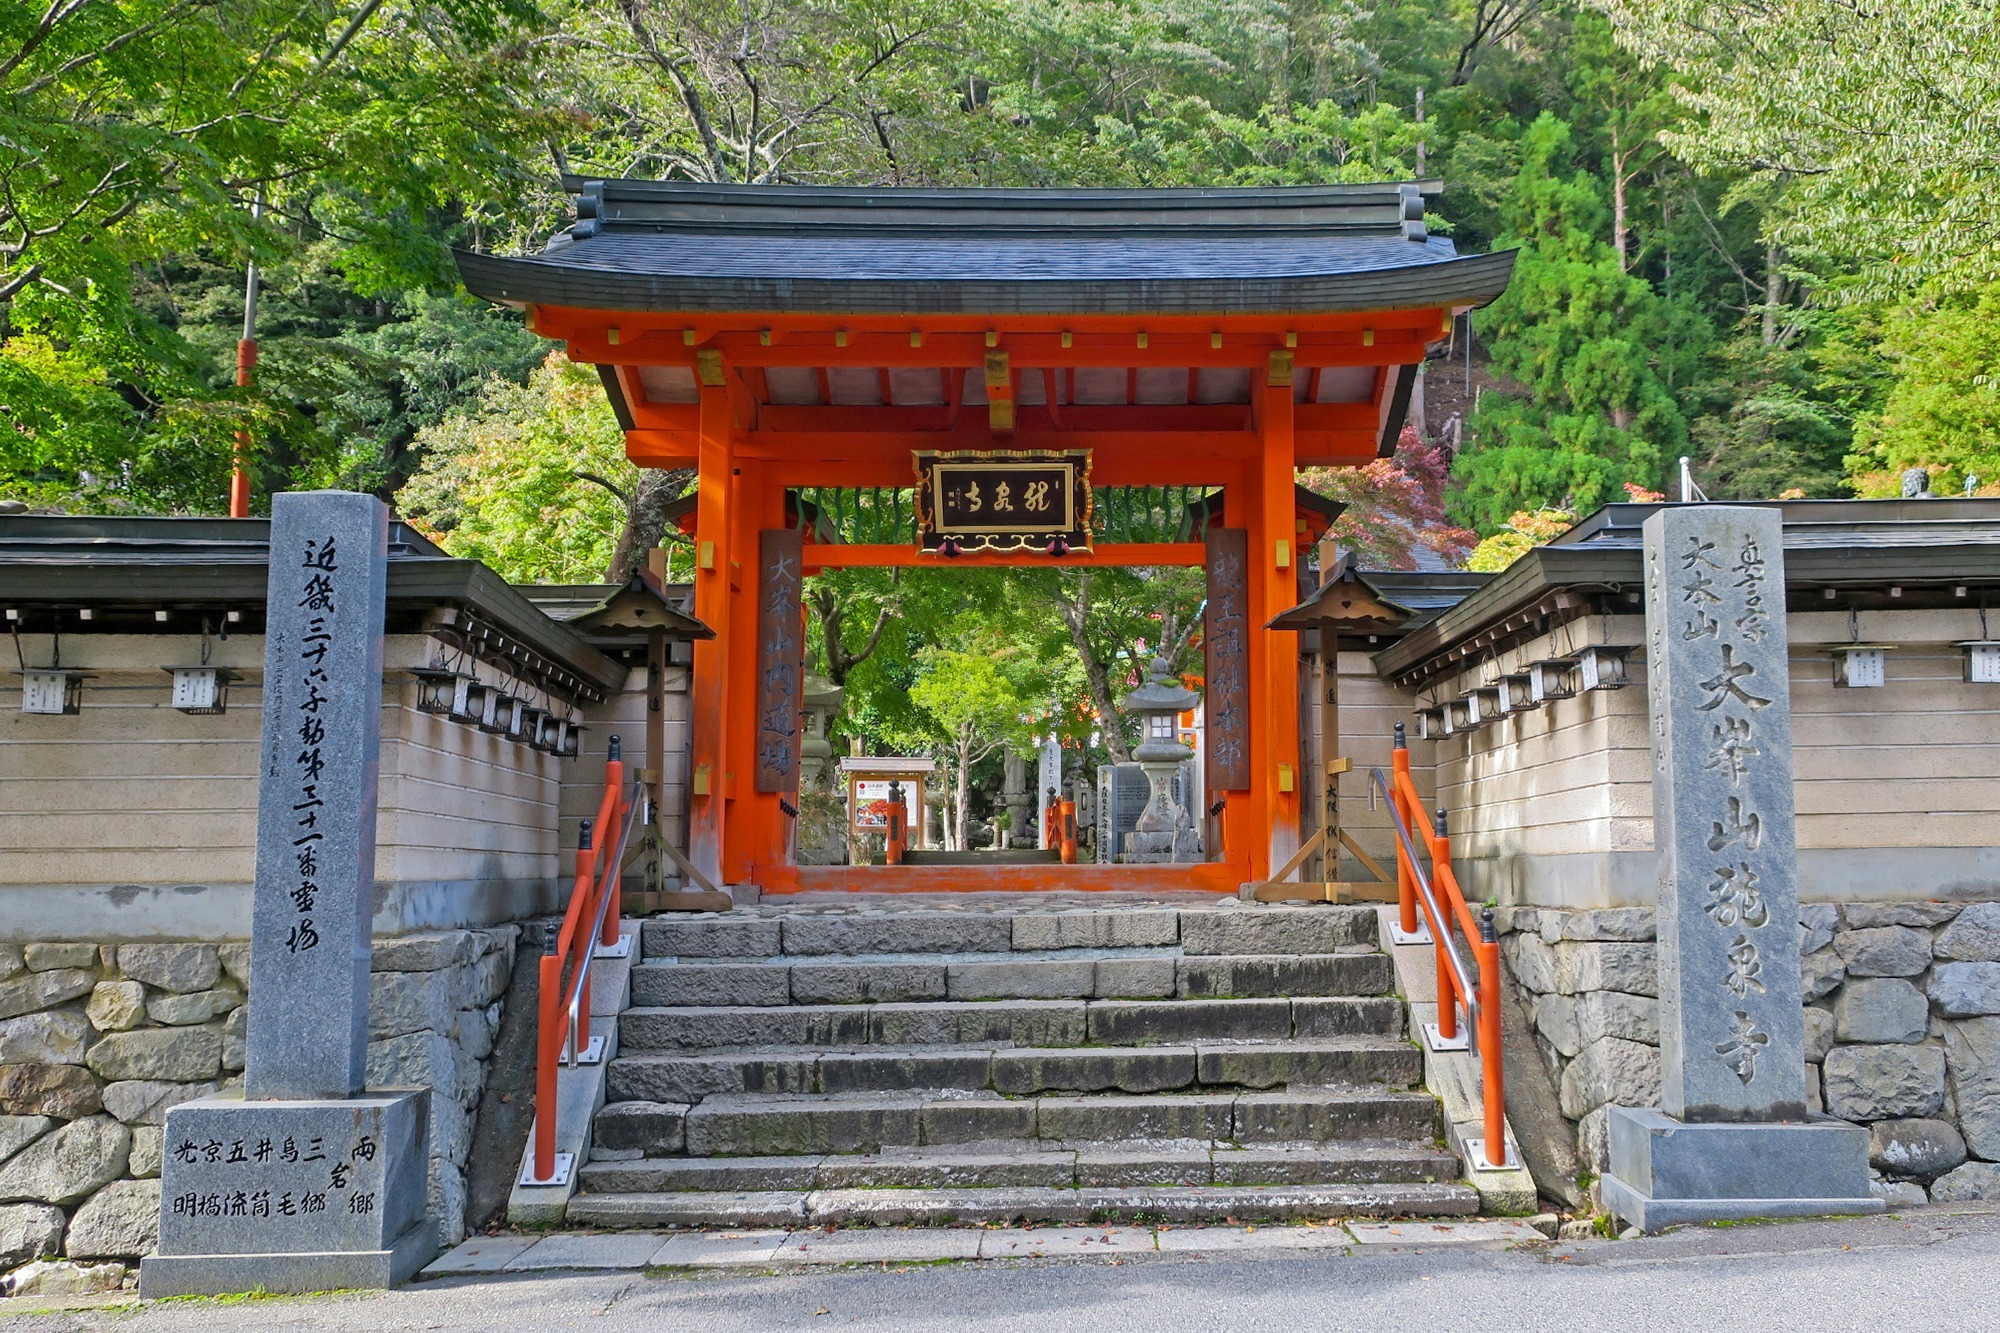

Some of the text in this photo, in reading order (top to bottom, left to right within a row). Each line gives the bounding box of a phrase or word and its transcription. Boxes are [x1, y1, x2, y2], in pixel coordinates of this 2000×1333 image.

[1211, 551, 1244, 777] 龍王講社本部
[1681, 536, 1723, 642] 大本山
[1731, 533, 1770, 643] 真言宗
[1695, 643, 1772, 1086] 大峯山龍泉寺
